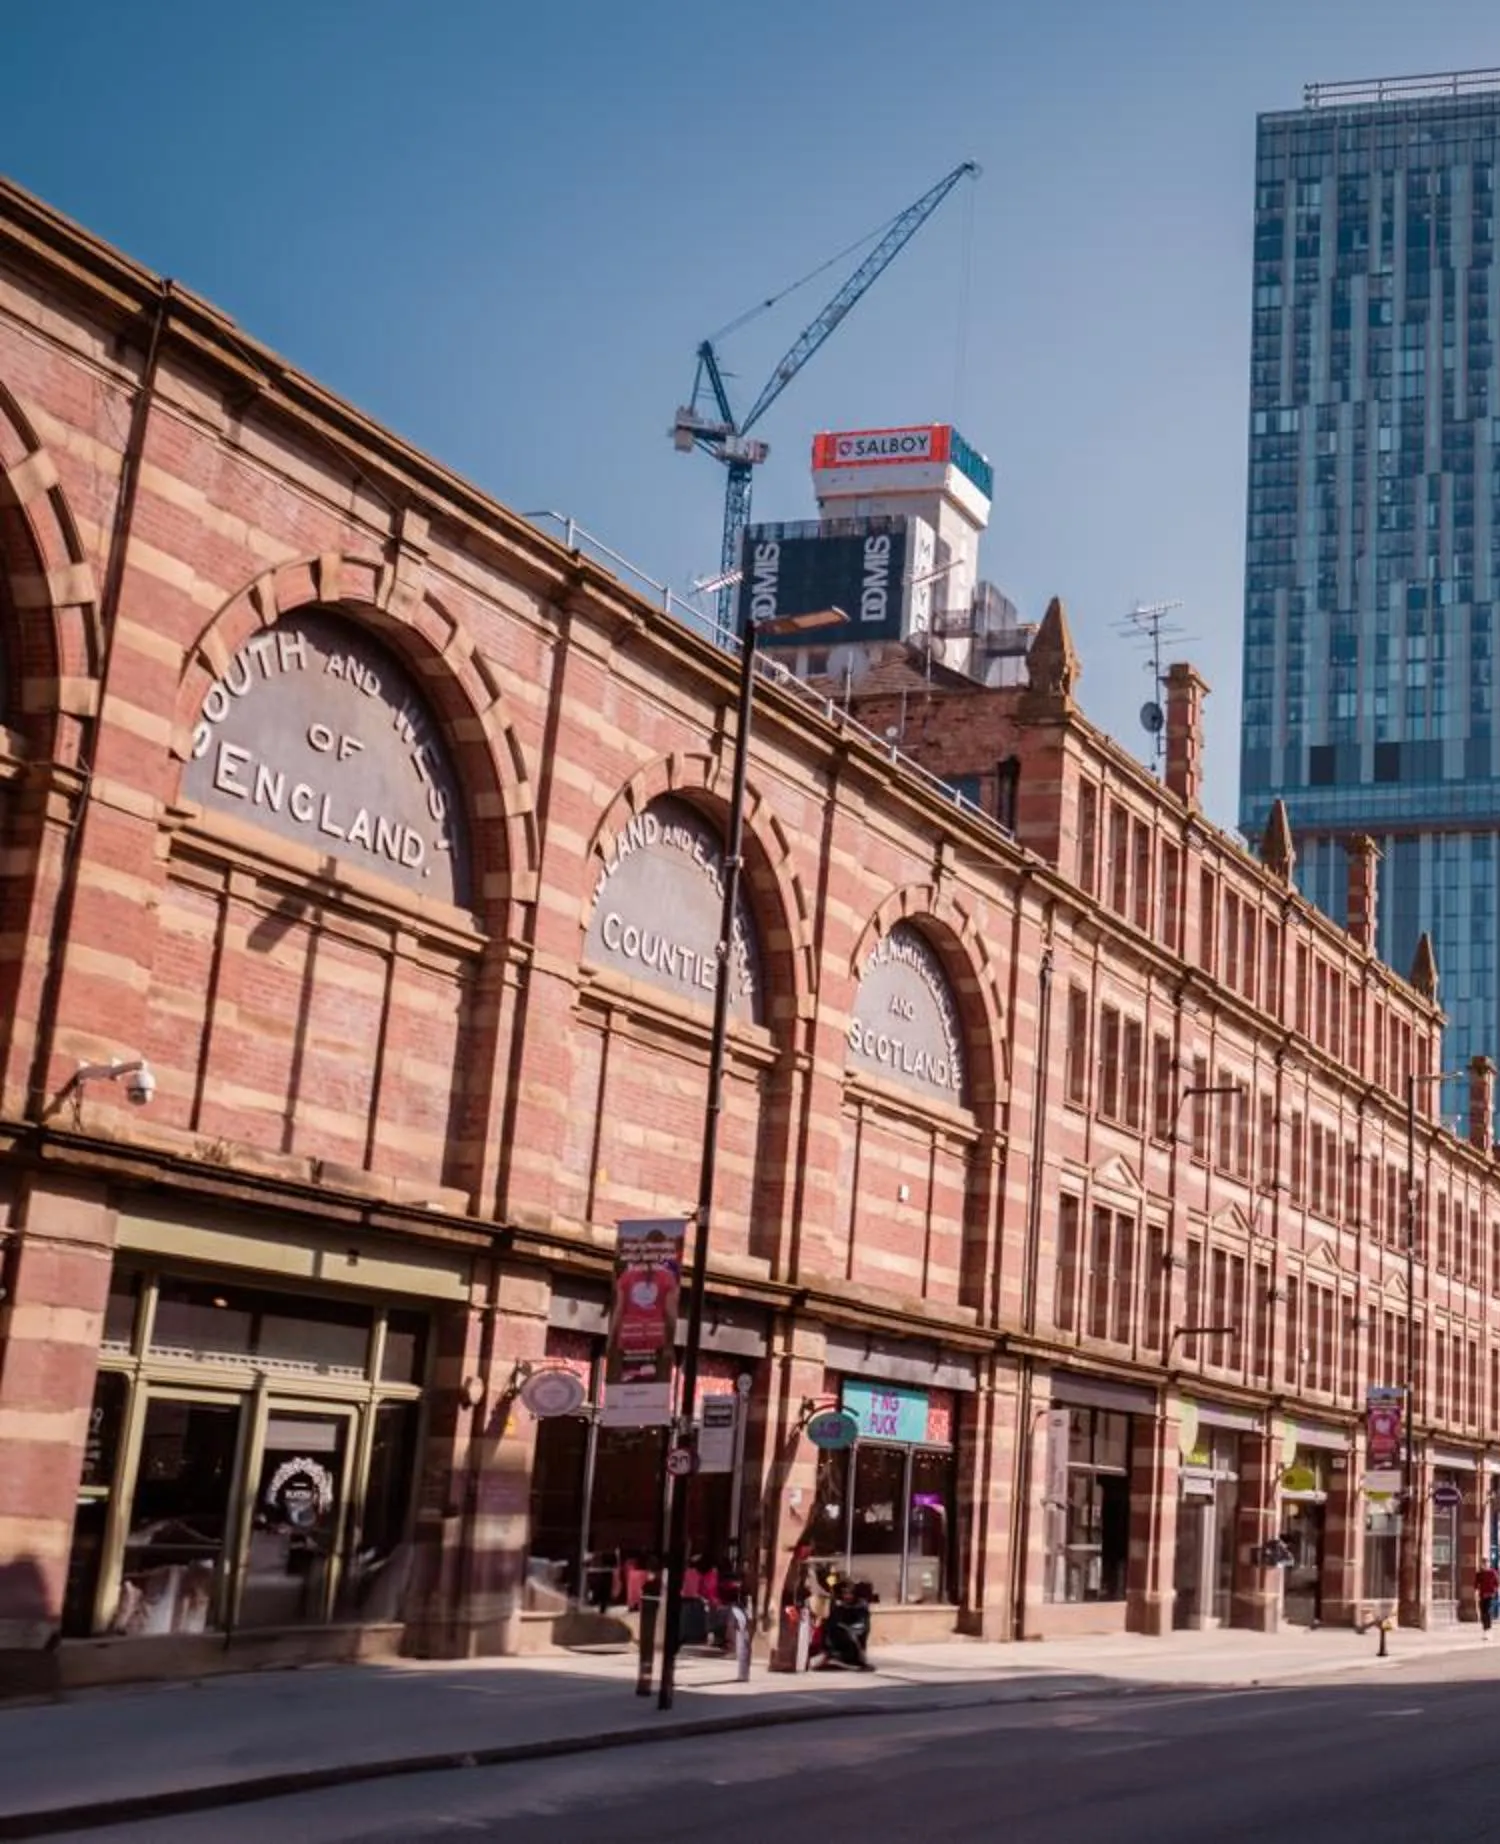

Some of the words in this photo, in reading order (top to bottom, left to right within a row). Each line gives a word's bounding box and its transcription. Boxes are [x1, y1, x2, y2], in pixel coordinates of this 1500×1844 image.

[856, 434, 928, 456] SALBOY
[861, 535, 892, 622] DOMIS
[325, 655, 383, 698] AND
[306, 722, 365, 763] OF
